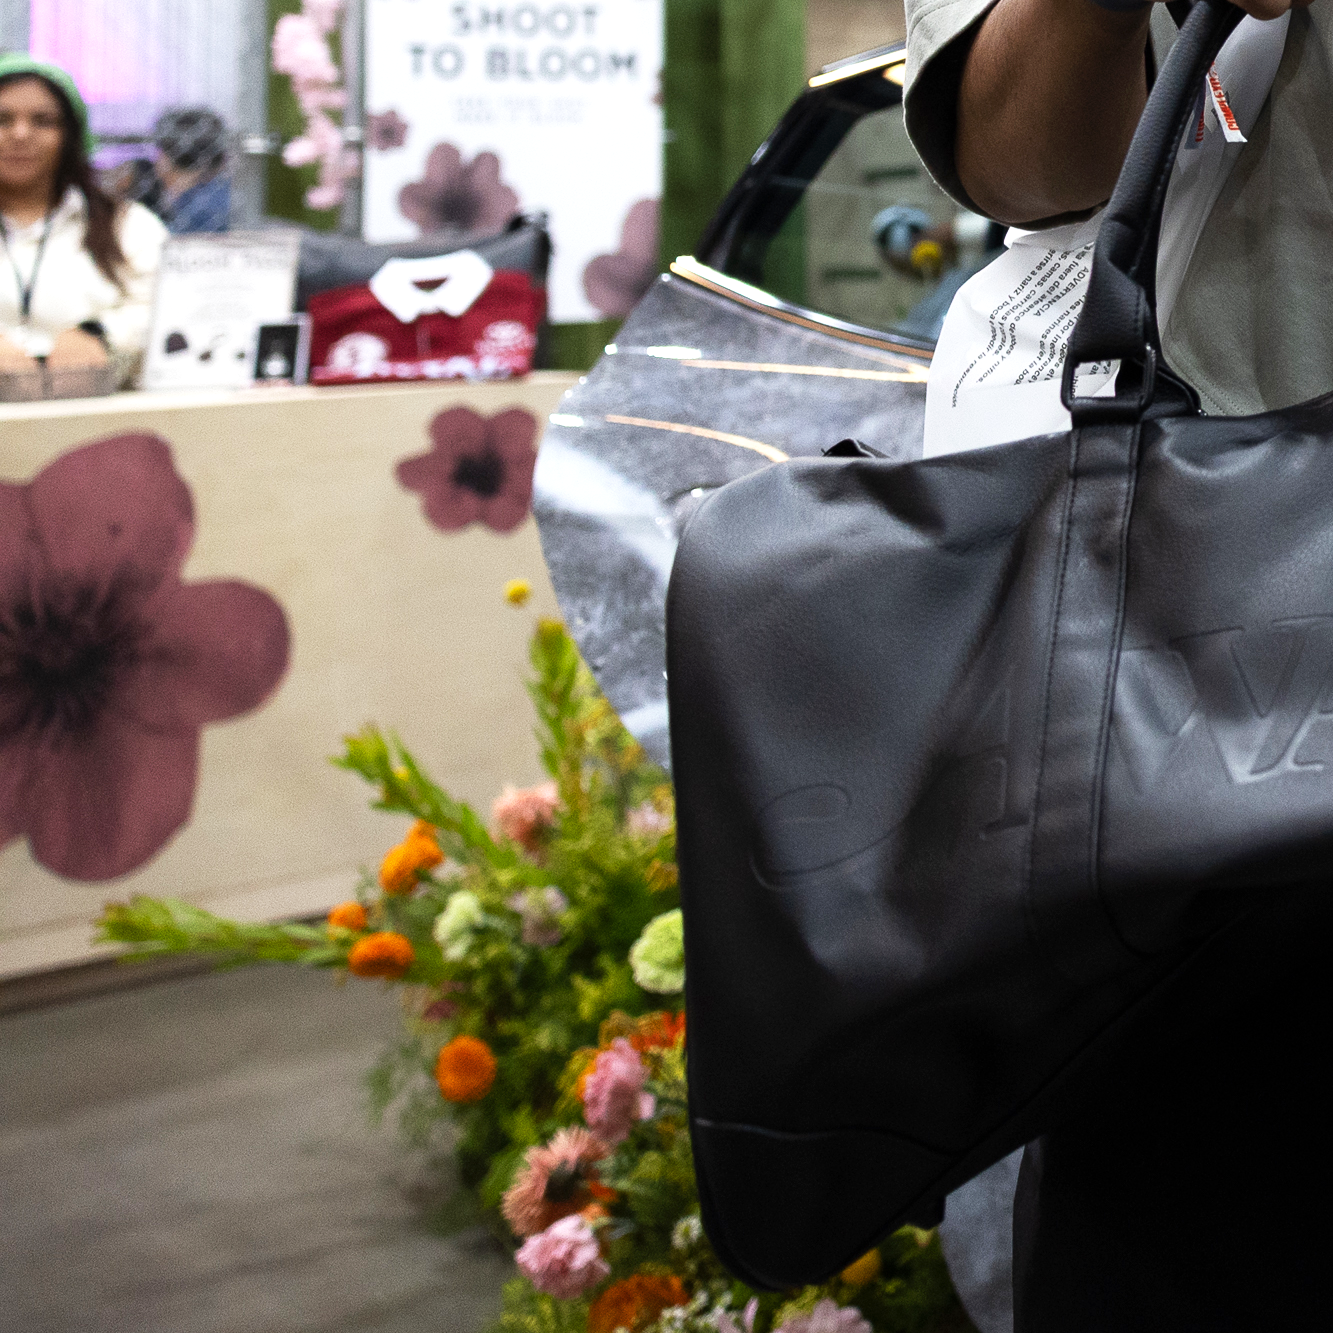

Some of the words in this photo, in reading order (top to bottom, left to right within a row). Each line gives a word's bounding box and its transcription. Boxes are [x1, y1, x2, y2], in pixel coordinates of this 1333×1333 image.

[451, 1, 599, 37] SHOOT
[409, 44, 464, 80] TO
[484, 45, 639, 82] BLOOM
[1034, 262, 1061, 288] camas,
[1058, 260, 1080, 281] fuera
[1013, 275, 1032, 296] nariz
[1033, 266, 1090, 317] ADVERTENCIA
[1046, 280, 1060, 295] del
[989, 300, 1010, 320] boca
